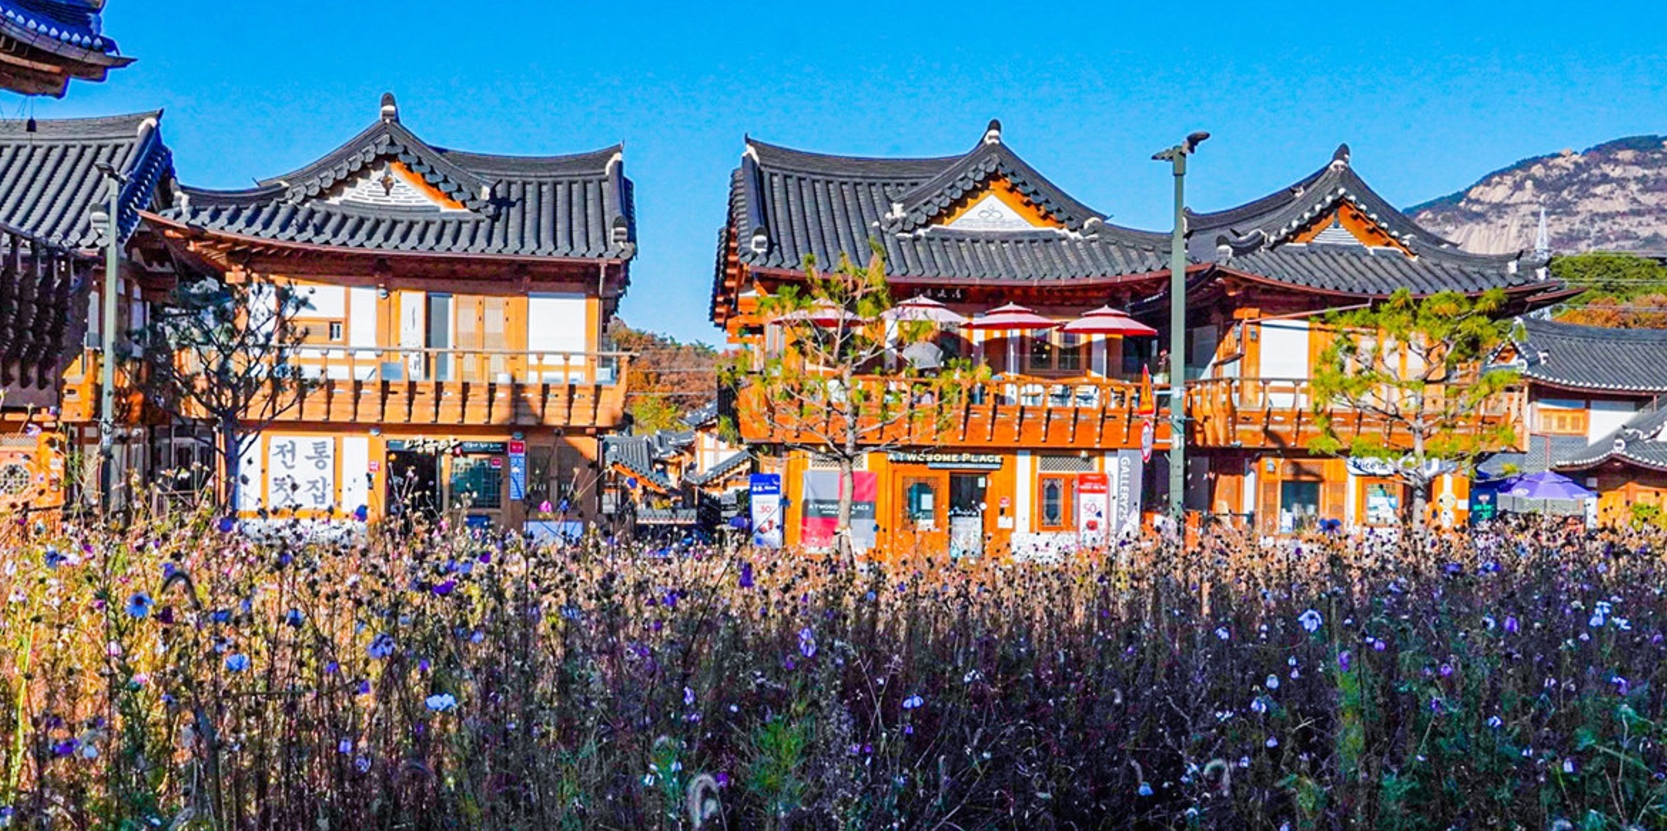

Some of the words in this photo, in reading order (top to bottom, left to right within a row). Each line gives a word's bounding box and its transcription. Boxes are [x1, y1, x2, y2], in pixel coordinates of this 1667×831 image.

[272, 440, 331, 470] 전통
[888, 453, 896, 461] A
[962, 452, 1002, 463] PLACE
[1119, 456, 1130, 520] GALLERY25
